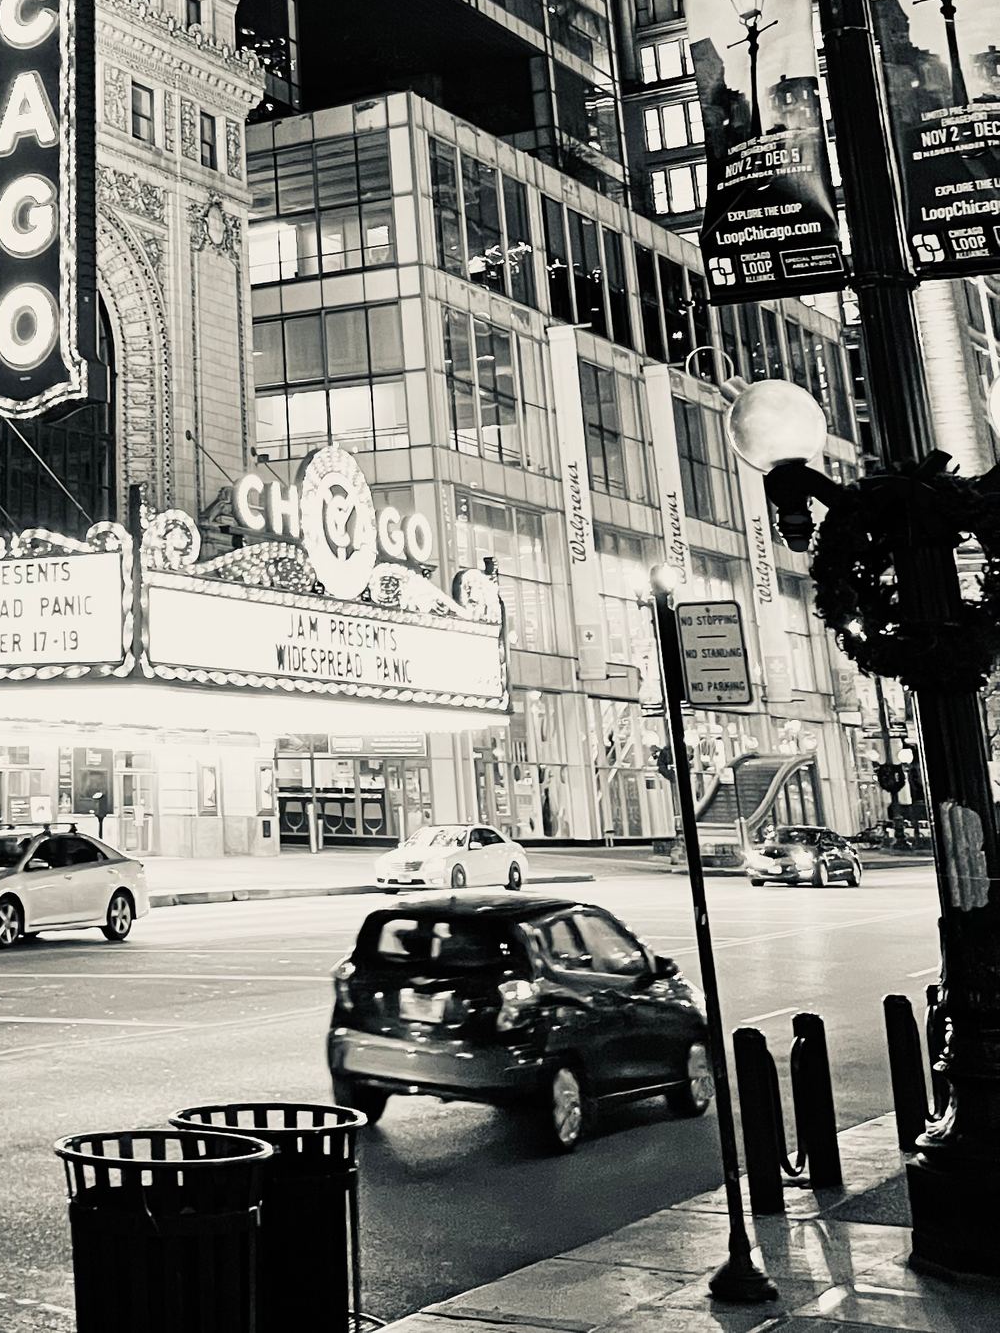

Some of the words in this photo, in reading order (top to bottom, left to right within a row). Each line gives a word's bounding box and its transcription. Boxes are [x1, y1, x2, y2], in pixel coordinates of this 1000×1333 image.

[921, 128, 947, 148] NOV
[950, 126, 960, 142] 2
[726, 158, 744, 178] NOV
[745, 156, 752, 170] 2
[765, 150, 790, 167] DEC
[791, 148, 800, 163] 5
[935, 181, 975, 197] EXPLORE
[975, 178, 994, 190] THE
[727, 208, 764, 222] EXPLORE
[764, 206, 780, 216] THE
[780, 202, 803, 215] LOOP
[921, 199, 1000, 221] LoopChicag
[715, 221, 822, 246] LoopChicago.com
[951, 235, 986, 251] LOOP
[740, 251, 771, 262] CHICAGO
[742, 260, 773, 276] LOOP
[567, 461, 590, 564] Walgreens
[751, 516, 774, 605] Walgreens
[40, 595, 93, 616] PANIC
[681, 616, 693, 626] NO
[696, 614, 739, 626] STOPPING
[287, 613, 319, 642] JAM
[330, 618, 398, 652] PRESENTS
[275, 643, 363, 679] WIDESPREAD
[376, 655, 412, 684] PANIC
[685, 649, 697, 659] NO
[701, 647, 742, 659] STANDING
[691, 682, 704, 692] NO
[707, 681, 746, 692] PARKING
